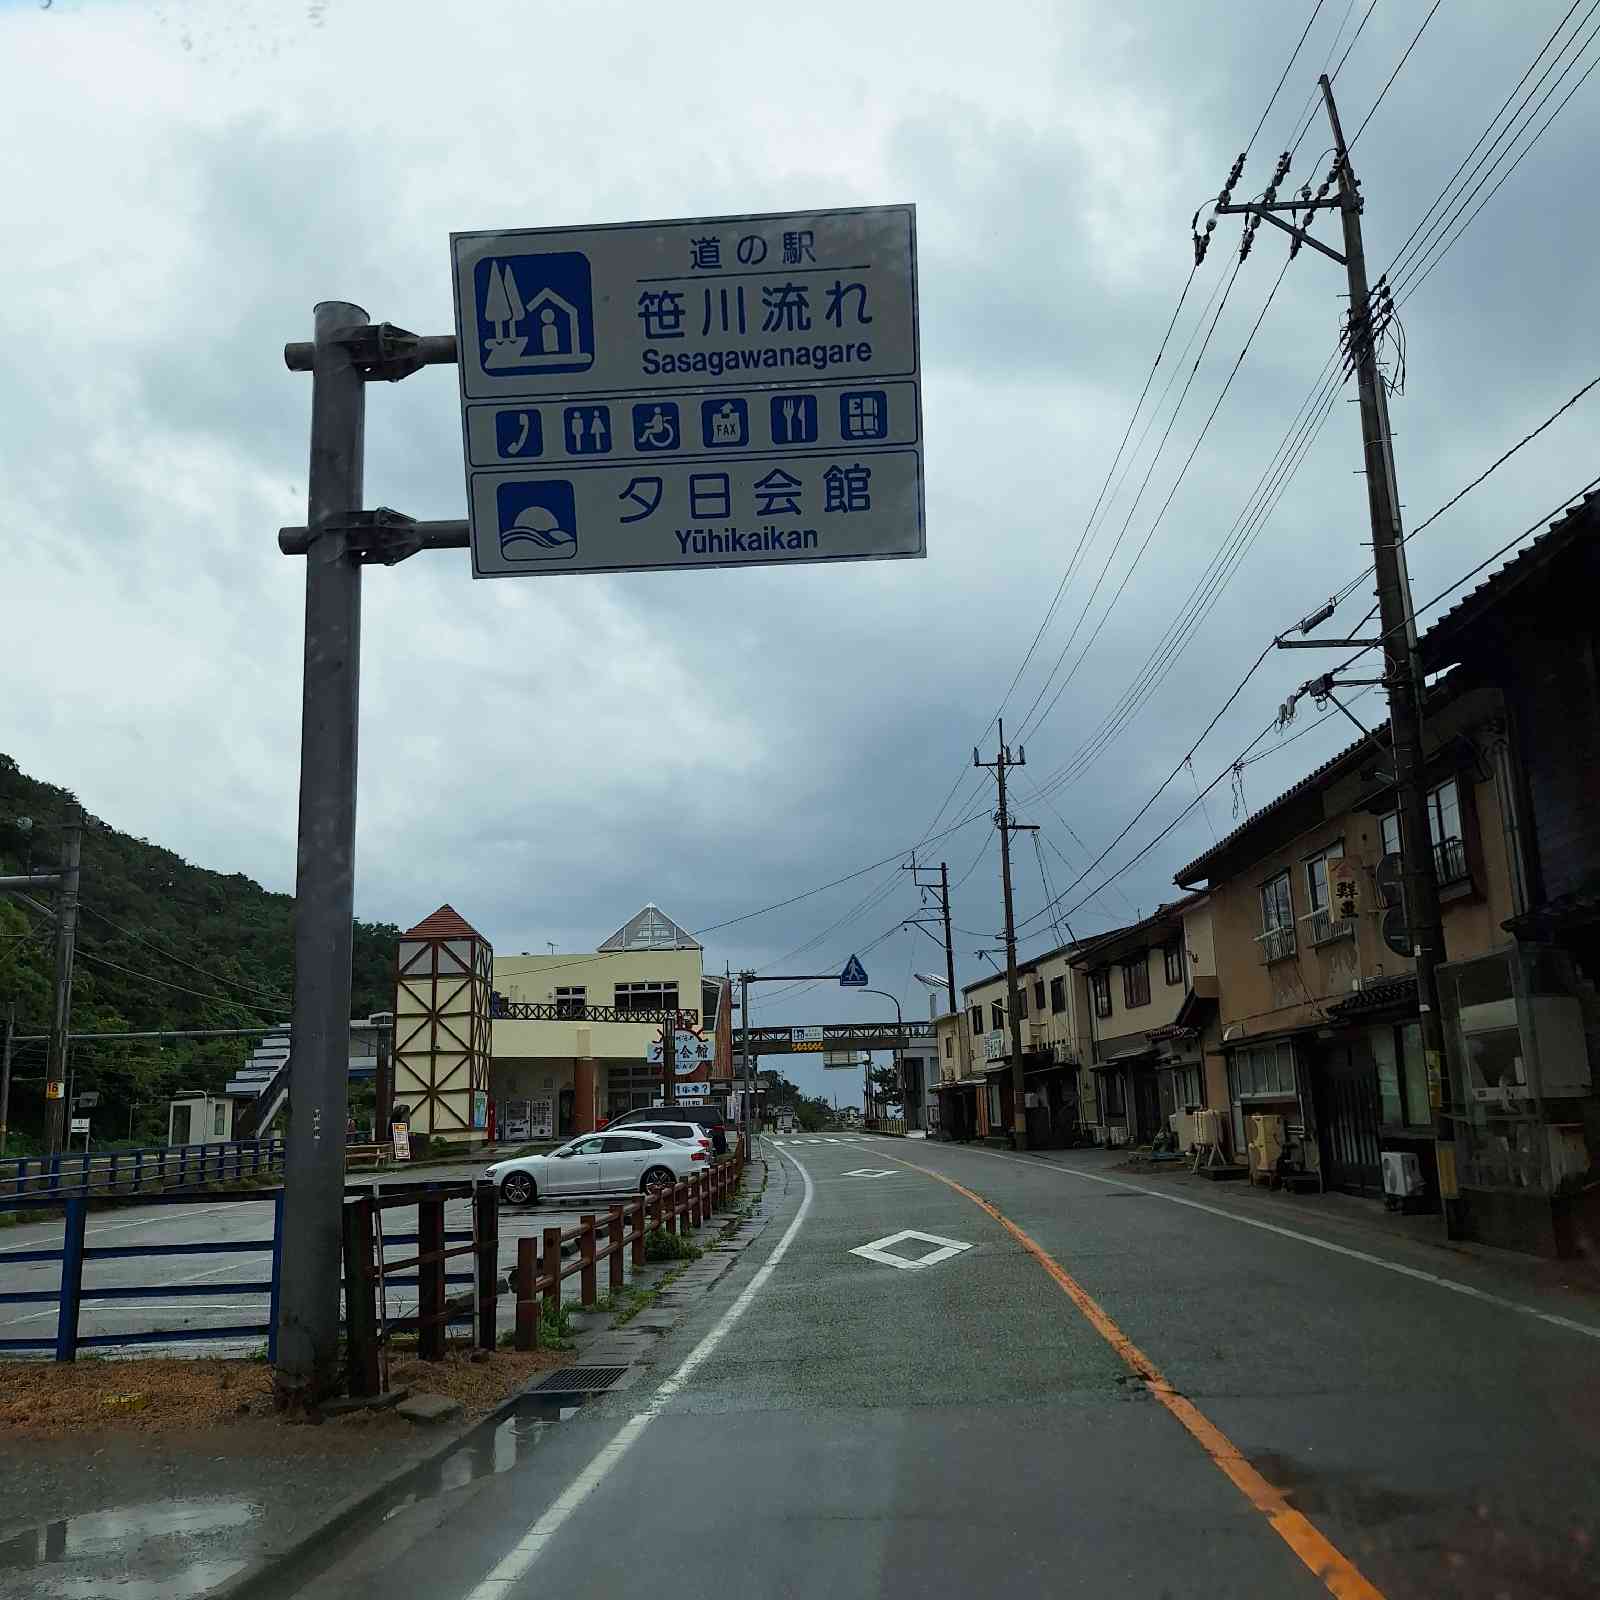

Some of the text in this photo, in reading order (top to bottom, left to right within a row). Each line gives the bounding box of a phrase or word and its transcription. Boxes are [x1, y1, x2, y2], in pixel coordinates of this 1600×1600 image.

[690, 230, 817, 270] 道の駅
[637, 279, 873, 340] 笹川流れ
[642, 340, 873, 376] Sasagawanagare
[716, 423, 736, 437] FAX
[618, 462, 872, 524] 夕日会館
[675, 526, 818, 555] Yūhikaikan
[652, 1044, 709, 1060] 夕会館
